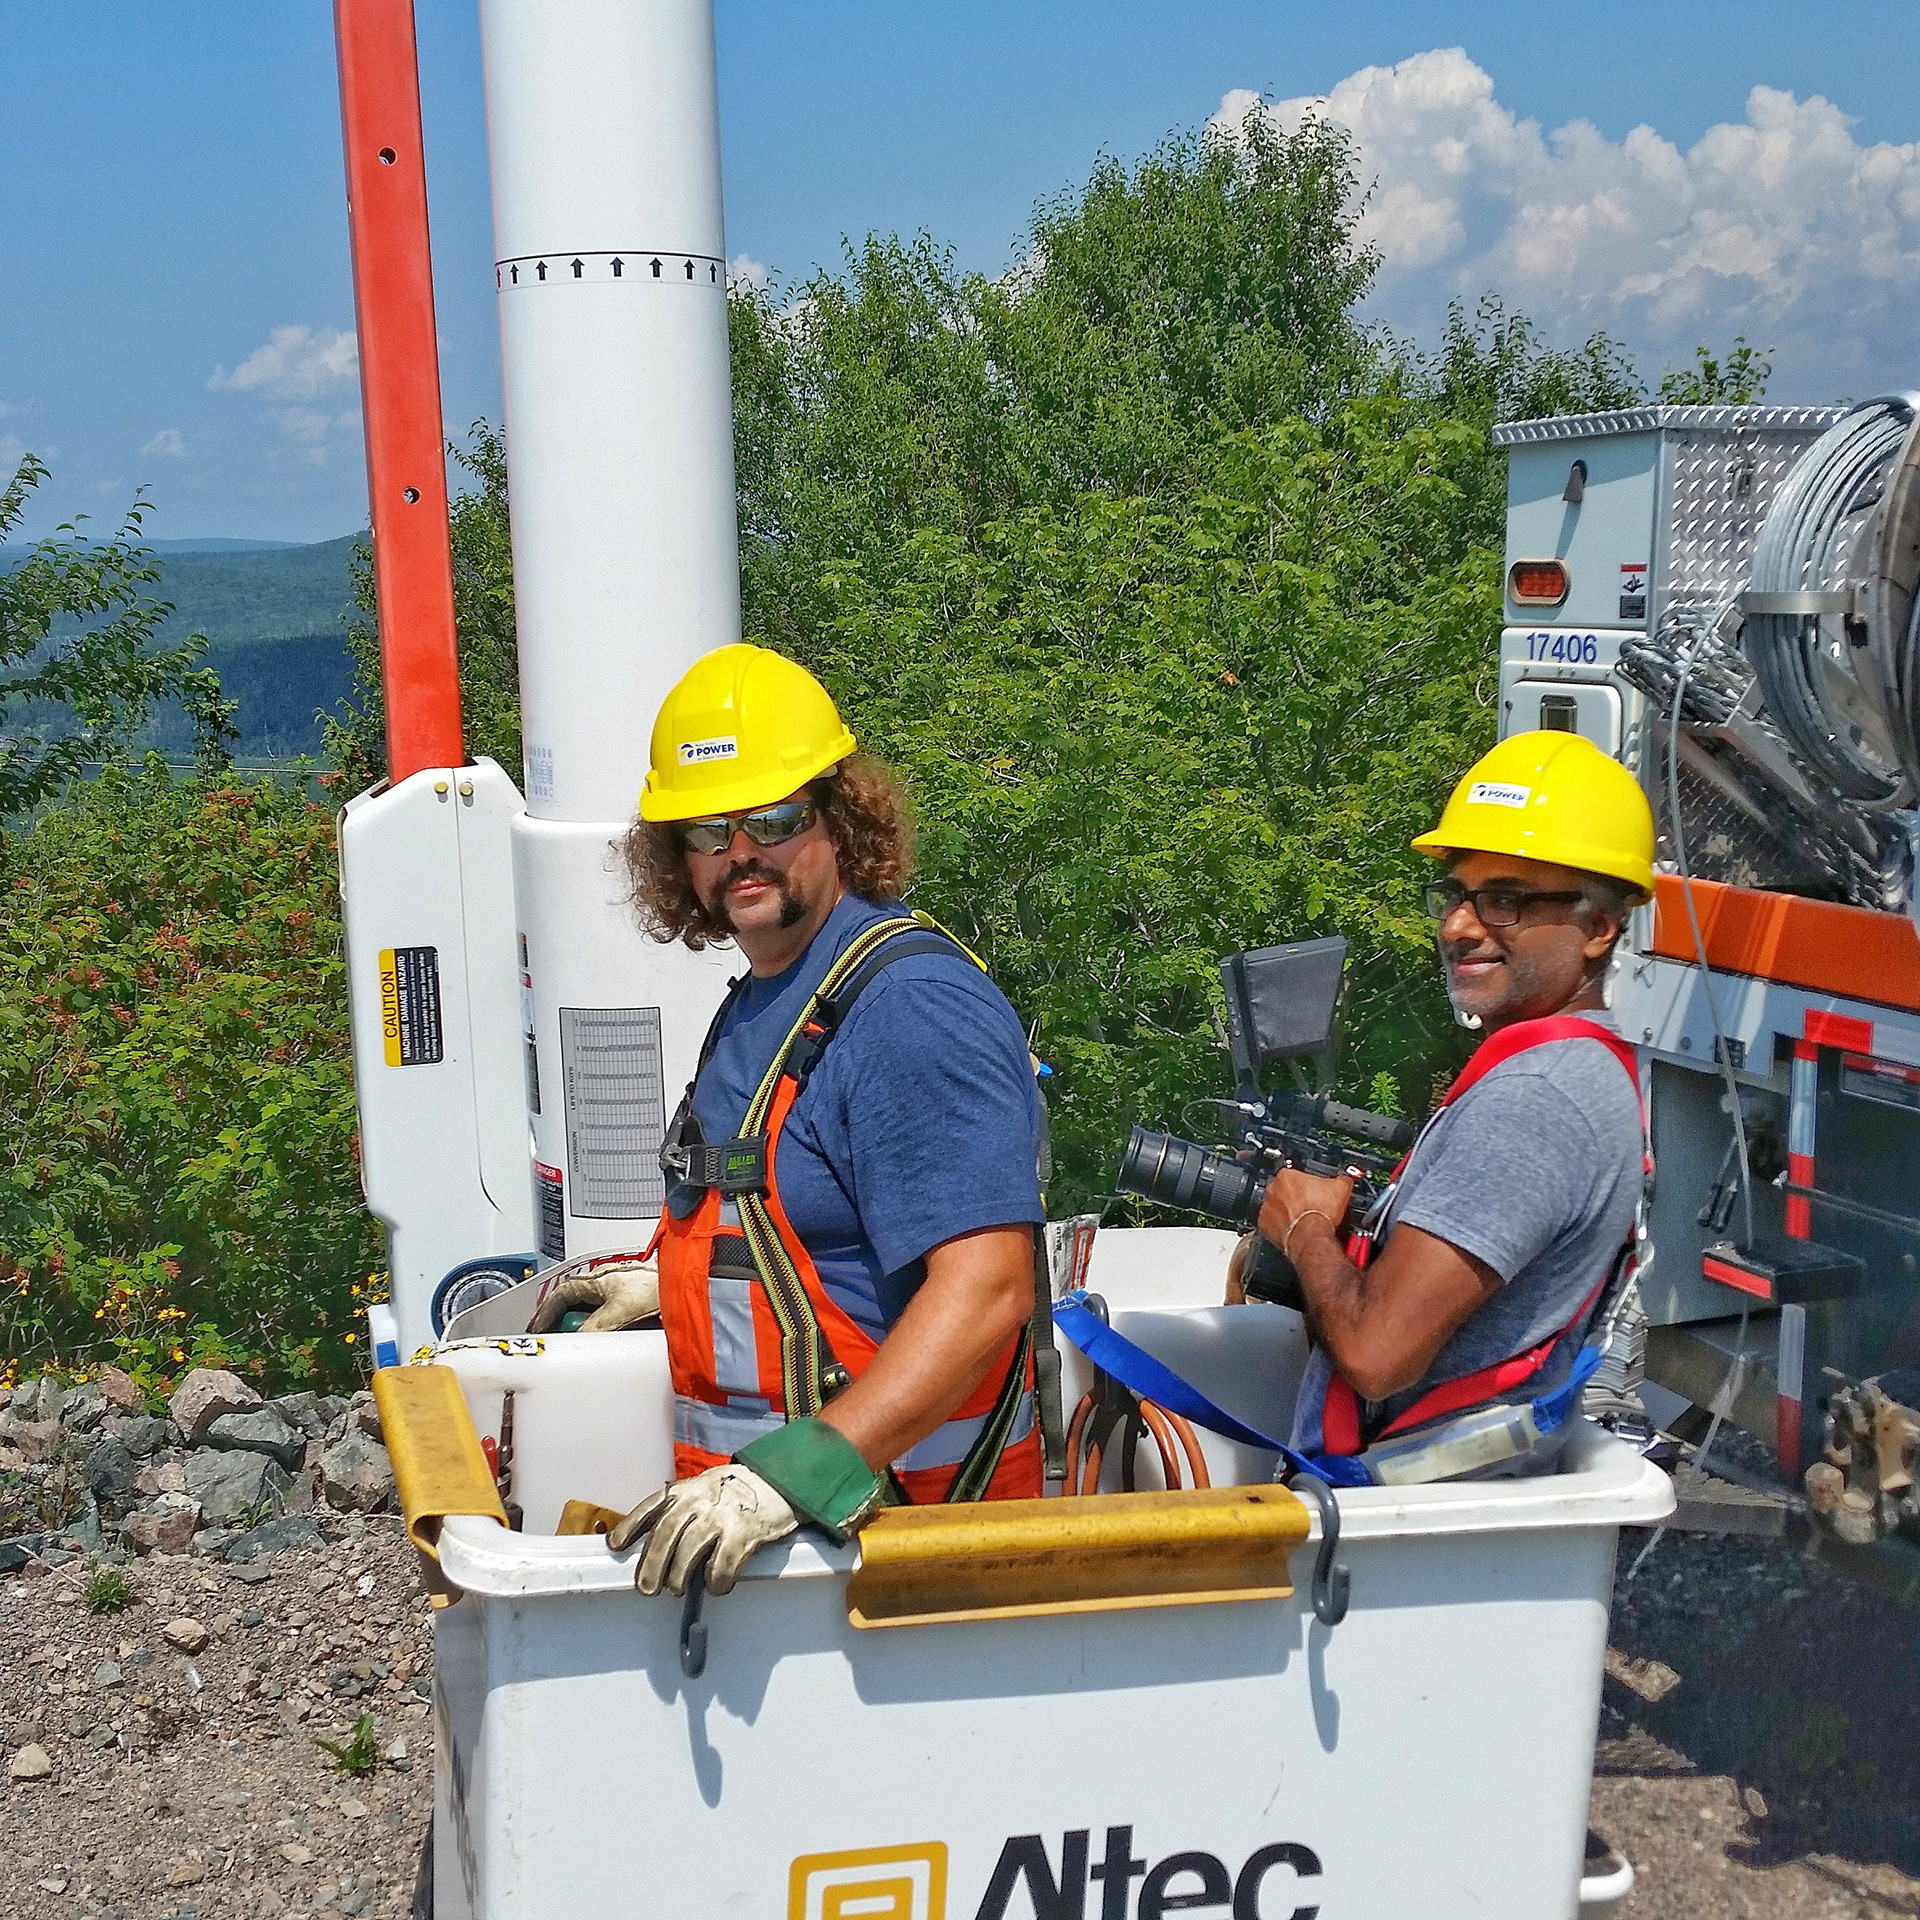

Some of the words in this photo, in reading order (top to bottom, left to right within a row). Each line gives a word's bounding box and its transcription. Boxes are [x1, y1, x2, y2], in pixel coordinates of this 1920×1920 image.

[1527, 632, 1597, 664] 17406
[696, 744, 736, 756] POWER
[397, 955, 408, 987] HAZARD
[381, 971, 398, 1038] CAUTION
[399, 989, 410, 1021] DAMAGE
[401, 1023, 412, 1059] MACHINE
[974, 1825, 1324, 1920] Altec
